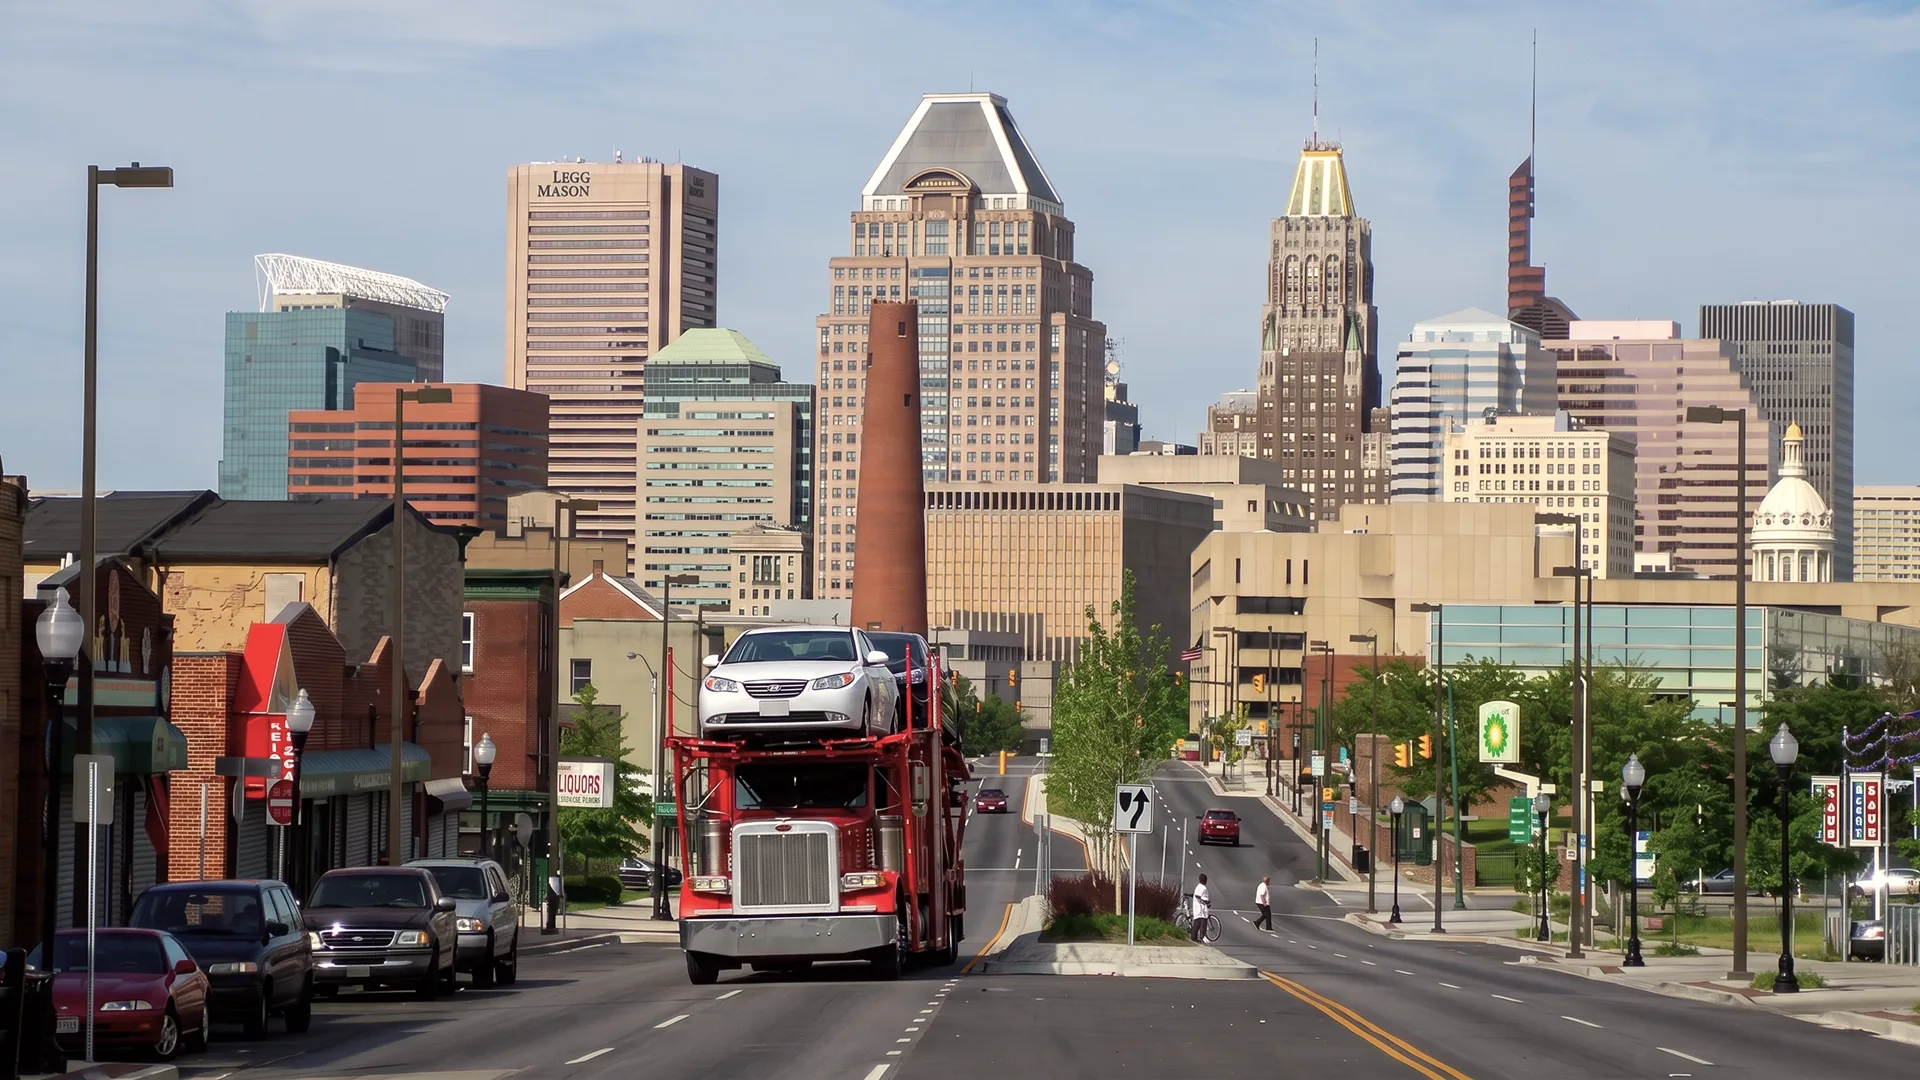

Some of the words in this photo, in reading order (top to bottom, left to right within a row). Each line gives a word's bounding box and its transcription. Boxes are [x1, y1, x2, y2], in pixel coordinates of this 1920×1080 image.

[553, 170, 591, 184] LEGG
[537, 184, 590, 197] MASON
[558, 773, 600, 795] LIQUORS
